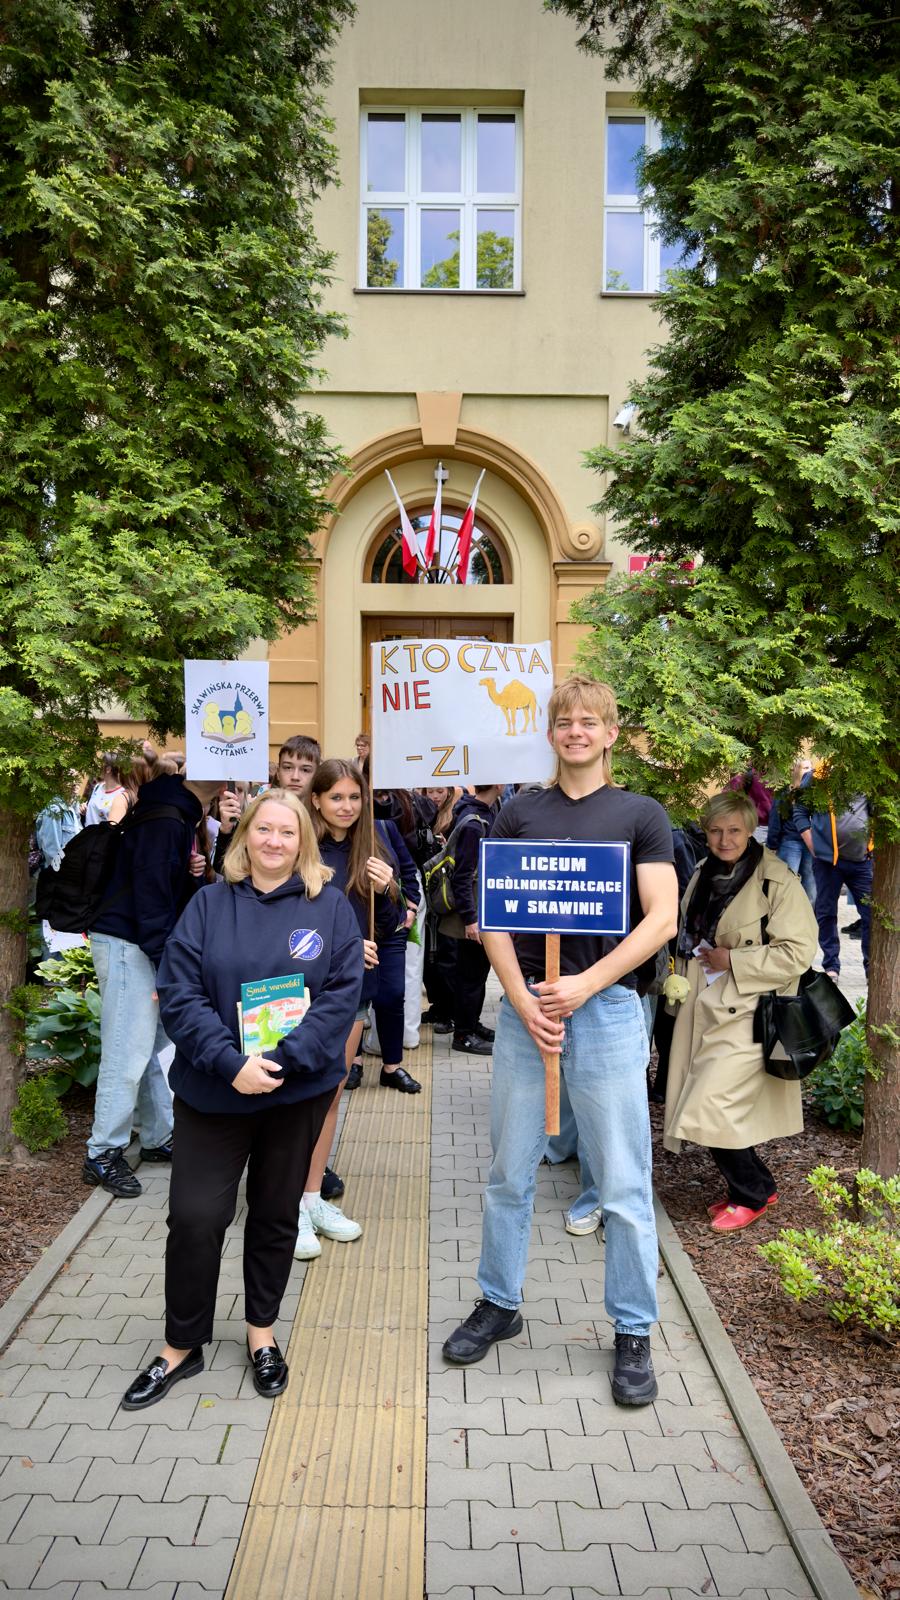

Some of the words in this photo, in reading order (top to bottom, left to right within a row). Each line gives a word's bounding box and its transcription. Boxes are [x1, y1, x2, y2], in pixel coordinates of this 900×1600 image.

[381, 643, 451, 675] KTO
[457, 643, 549, 675] CZYTA
[191, 681, 233, 715] SKAWIŃSKA
[234, 682, 266, 717] PRZERWA
[382, 680, 431, 712] NIE
[209, 745, 248, 757] CZYTANIE
[521, 856, 587, 872] LICEUM
[504, 899, 519, 913] W
[527, 900, 604, 916] SKAWINIE
[246, 984, 268, 997] Smok
[269, 978, 301, 992] wawelski
